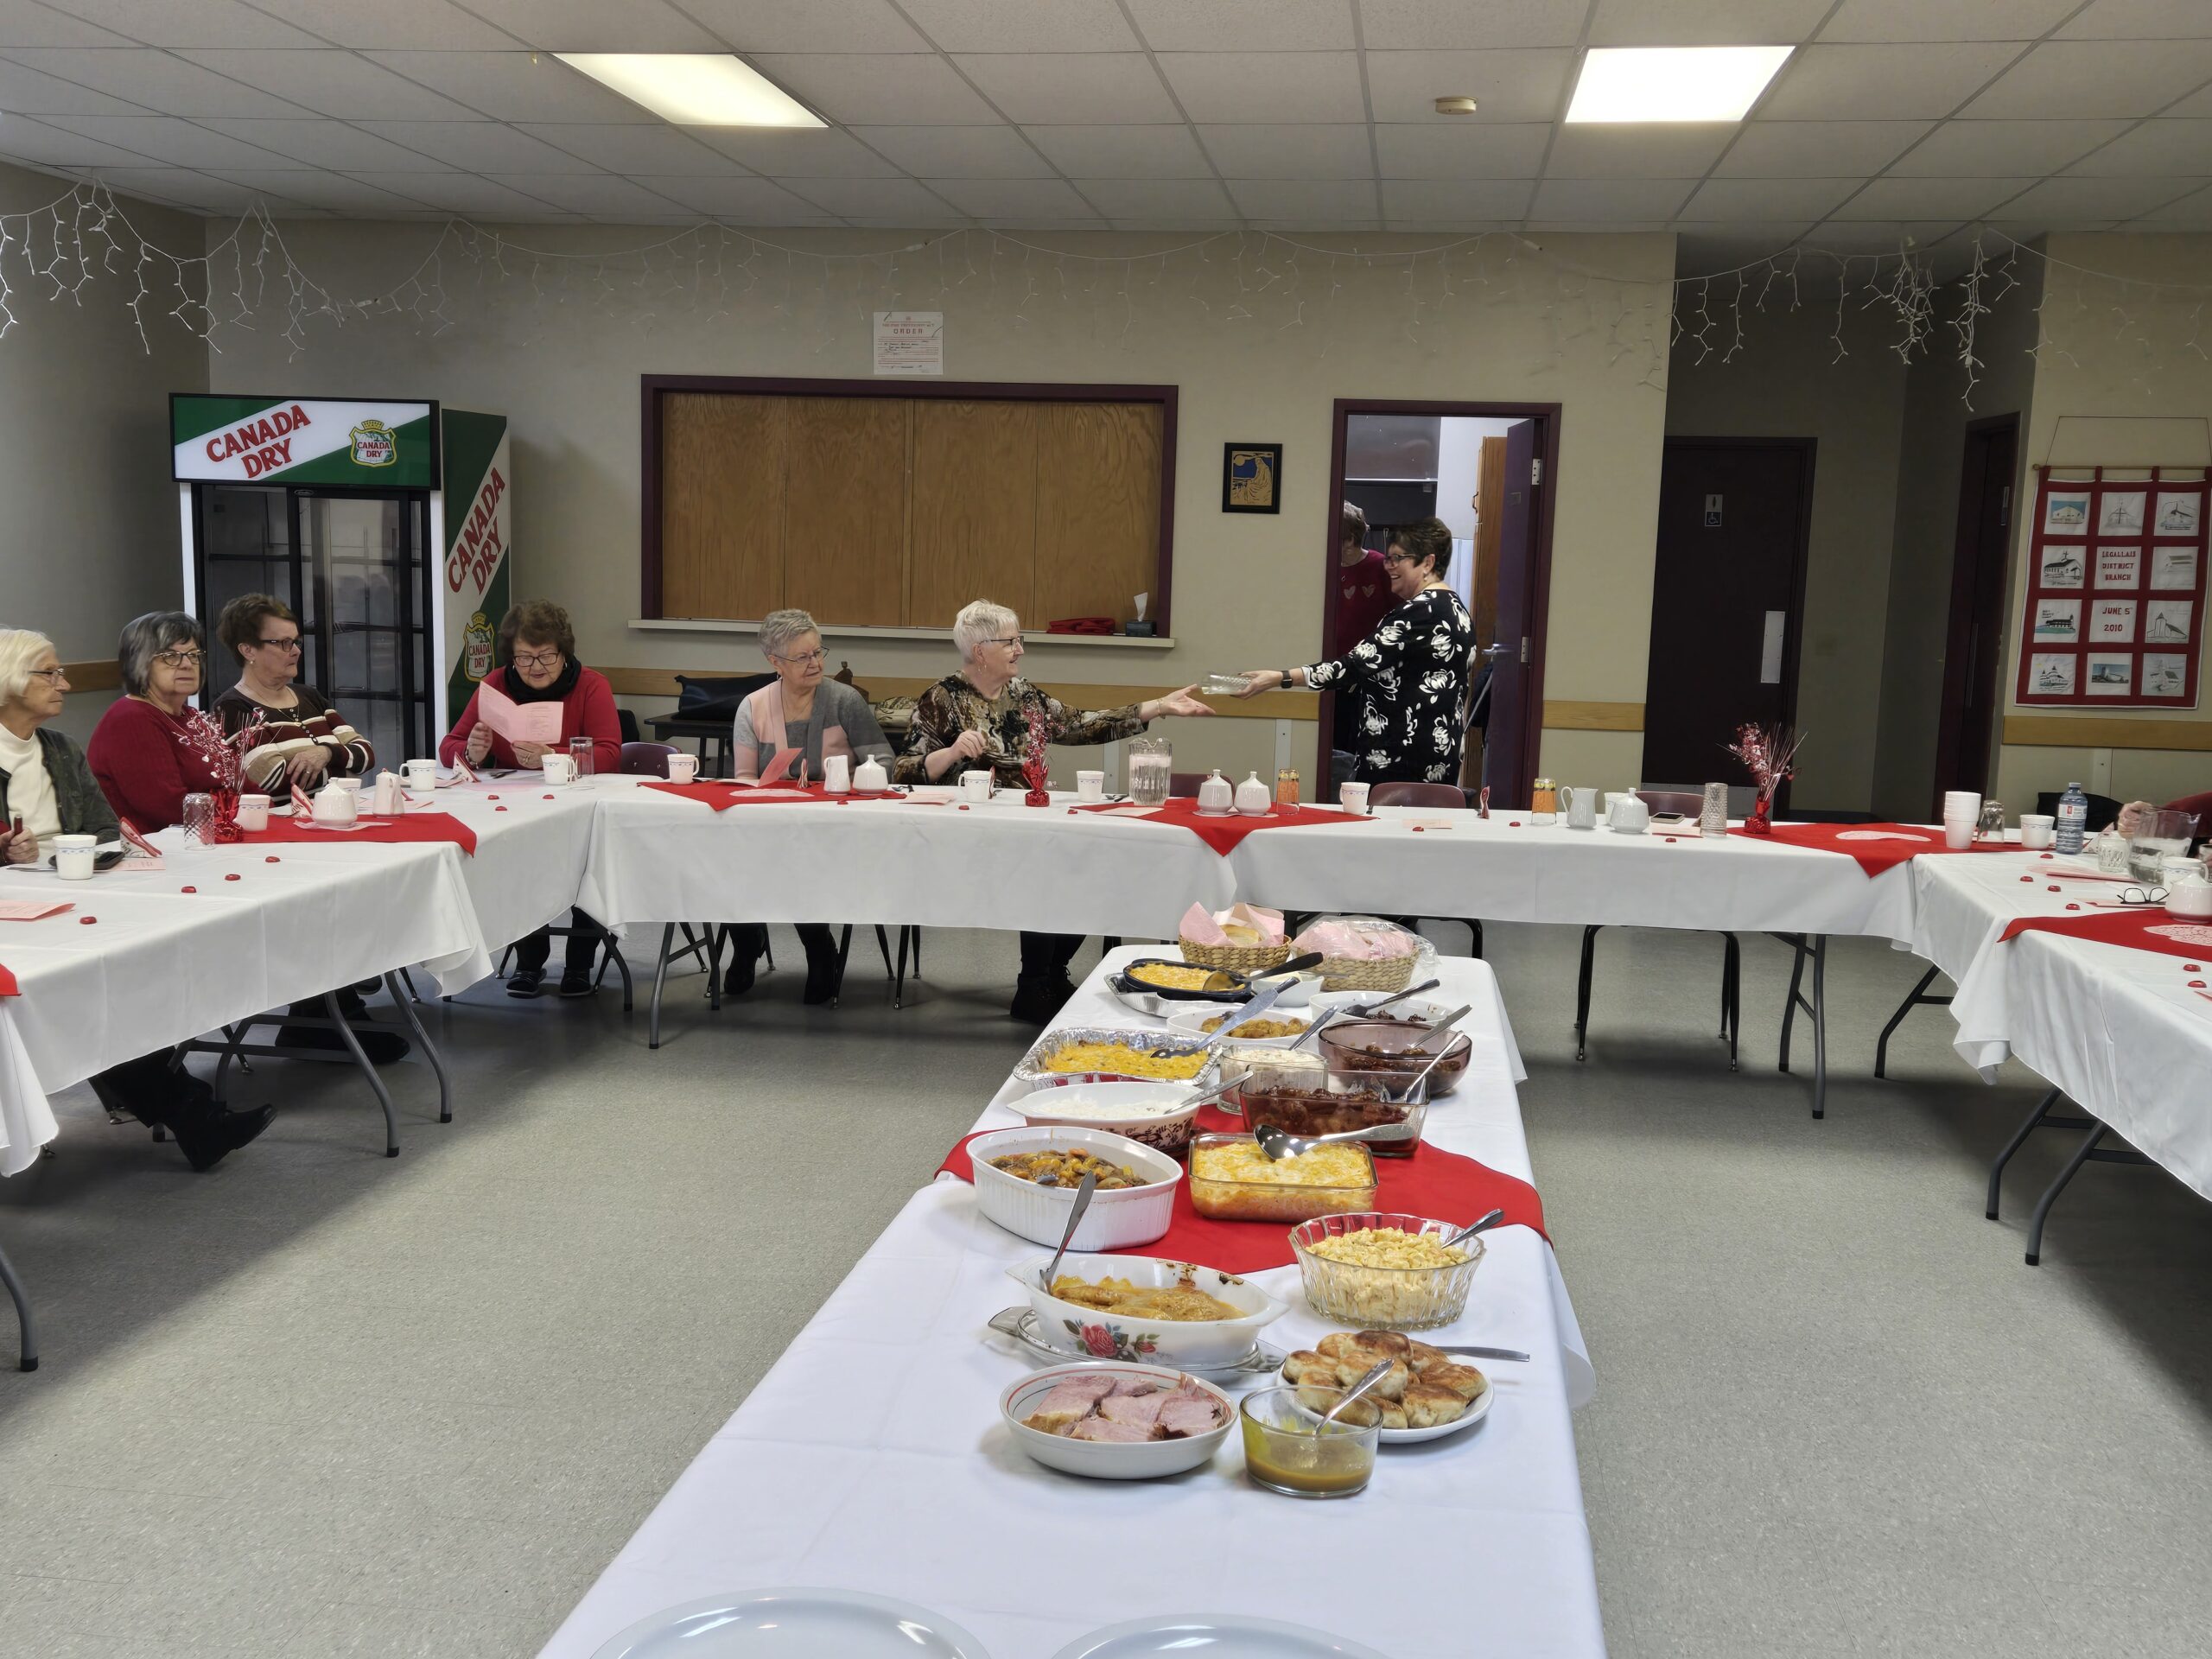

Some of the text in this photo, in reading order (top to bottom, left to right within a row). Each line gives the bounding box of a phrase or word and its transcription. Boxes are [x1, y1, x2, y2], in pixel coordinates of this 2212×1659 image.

[207, 404, 311, 462] CANADA
[241, 438, 292, 479] DRY
[448, 467, 505, 593] CANADA
[472, 516, 502, 595] DRY
[468, 643, 491, 657] CANADA
[474, 657, 485, 669] DRY
